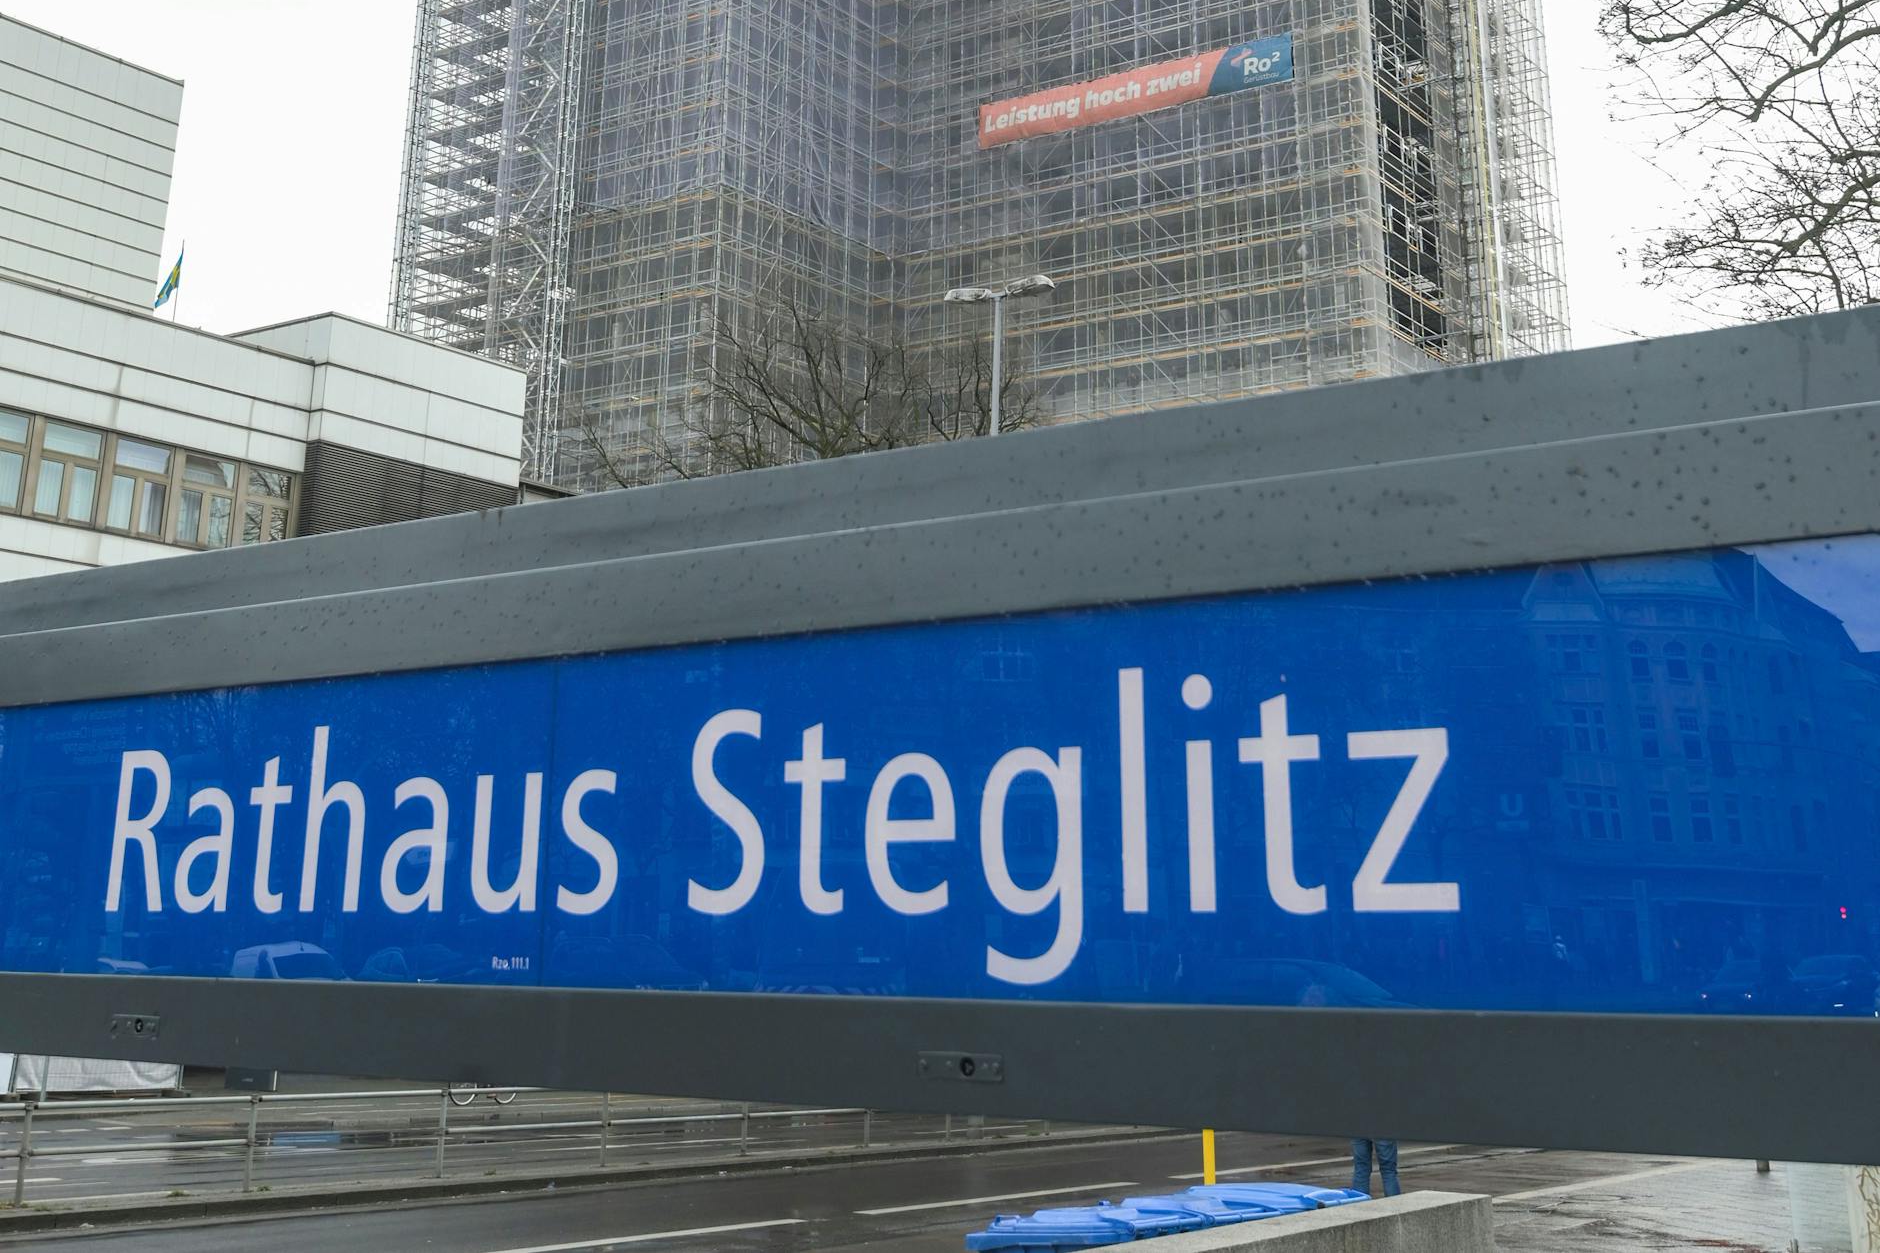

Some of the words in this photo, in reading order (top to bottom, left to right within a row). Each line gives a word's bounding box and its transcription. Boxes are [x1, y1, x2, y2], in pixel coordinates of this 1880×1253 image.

[984, 98, 1080, 133] Leistung
[1084, 82, 1141, 110] hoch
[1147, 62, 1202, 94] zwei
[105, 726, 618, 915] Rathaus
[687, 667, 1461, 986] Steglitz
